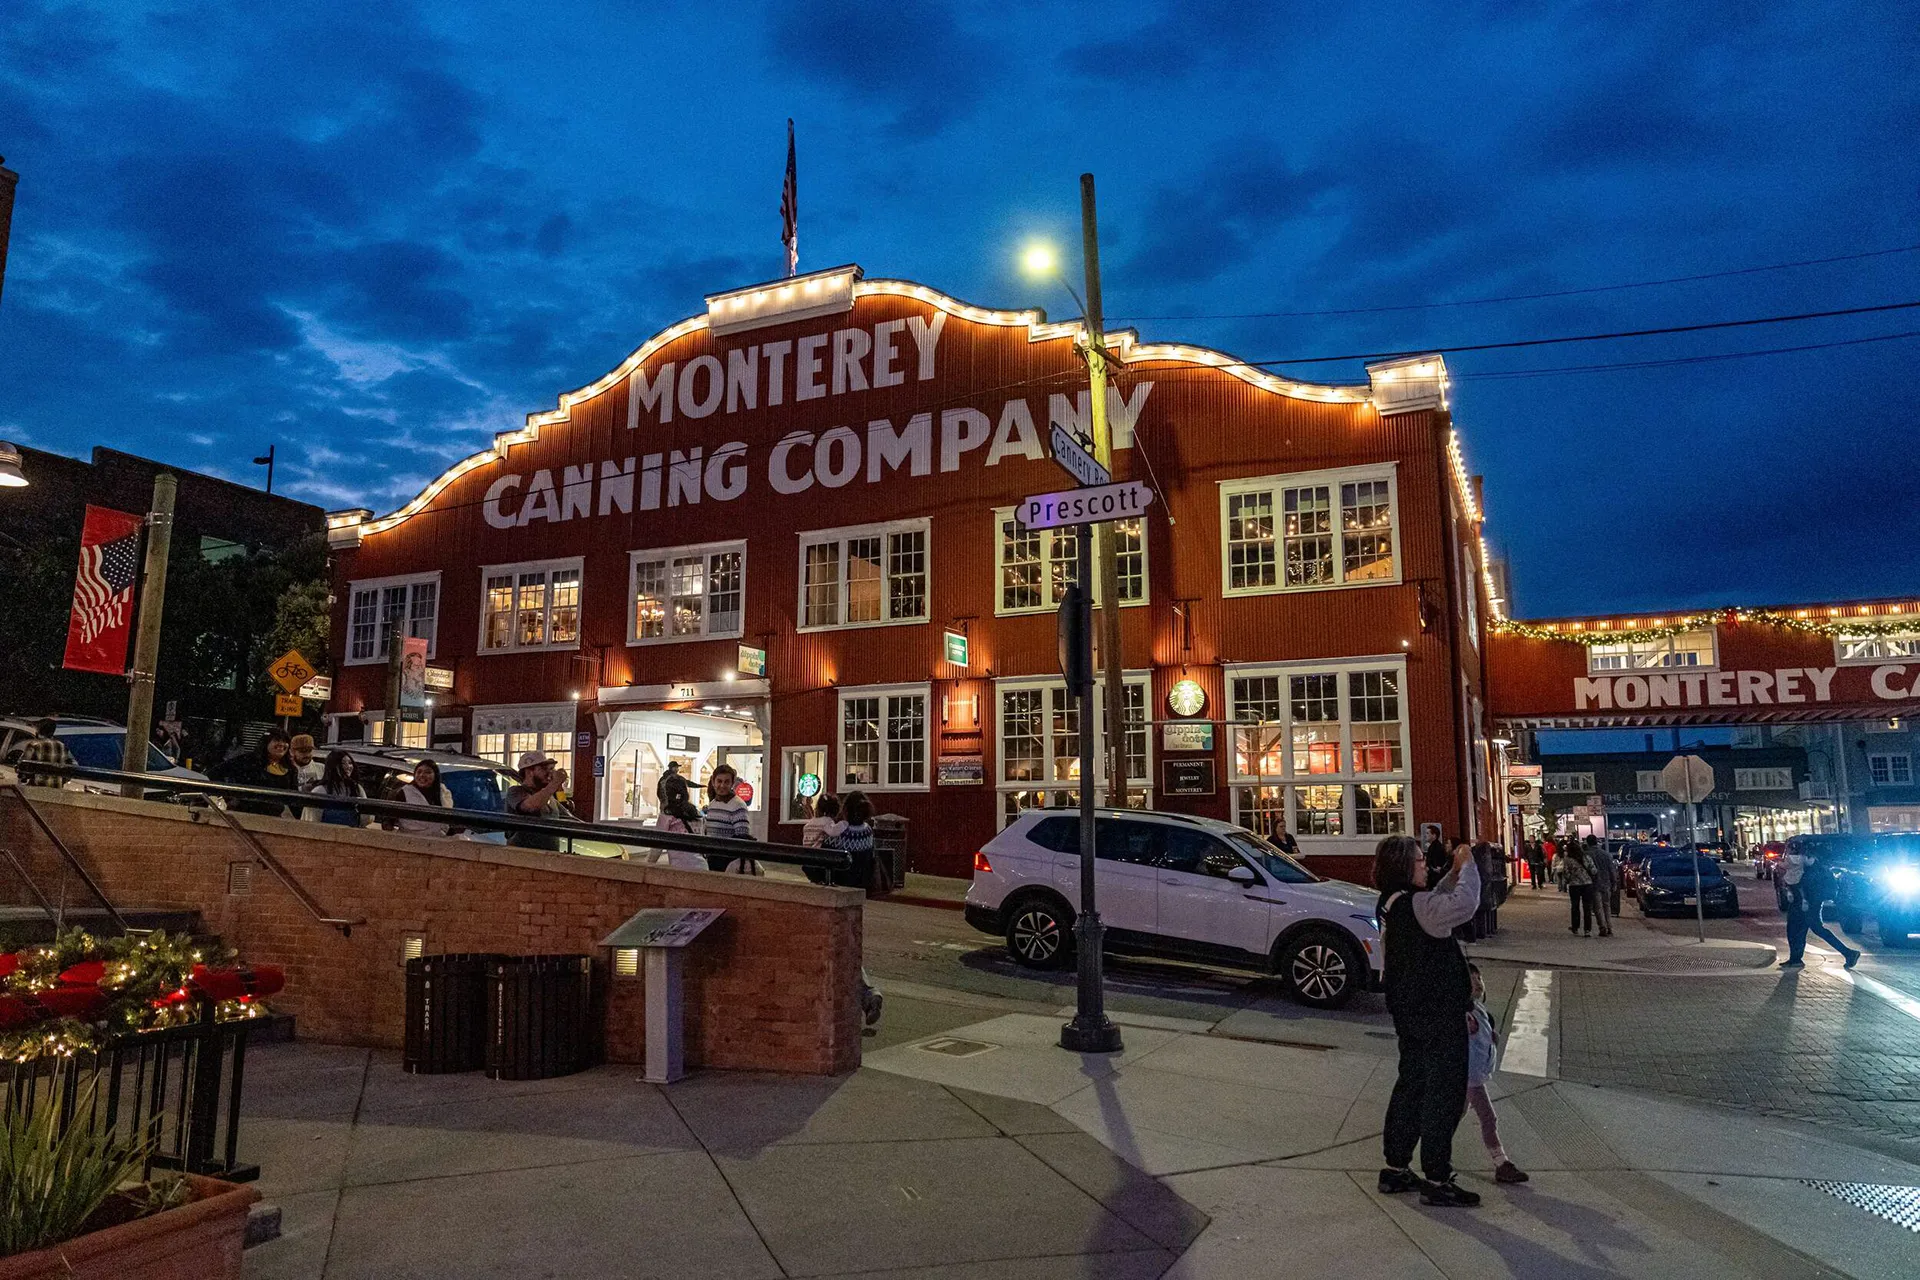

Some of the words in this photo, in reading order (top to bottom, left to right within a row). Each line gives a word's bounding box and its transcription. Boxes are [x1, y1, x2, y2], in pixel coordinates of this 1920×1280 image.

[627, 311, 947, 429] MONTEREY
[483, 441, 749, 529] CANNING
[768, 381, 1155, 495] COMPANY
[1055, 432, 1091, 486] Cannery
[1030, 487, 1138, 523] Prescott
[680, 688, 695, 697] 711
[1573, 667, 1837, 710] MONTEREY
[1604, 793, 1621, 801] THE
